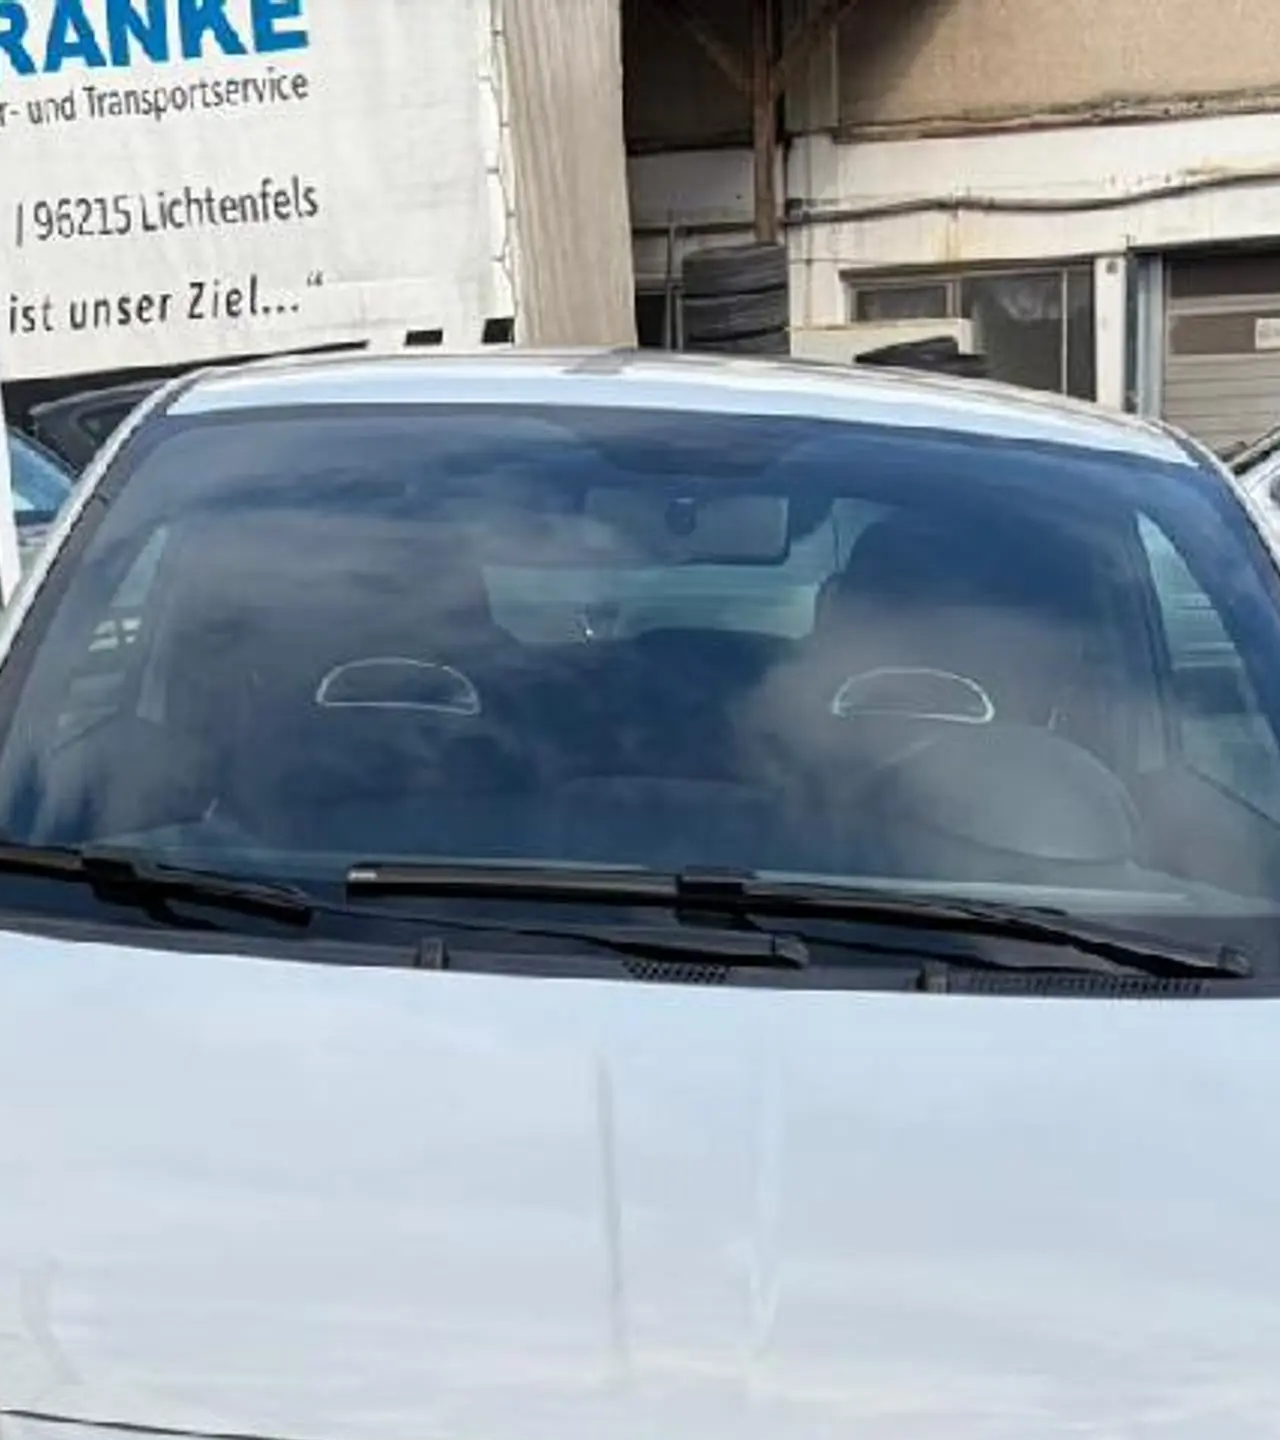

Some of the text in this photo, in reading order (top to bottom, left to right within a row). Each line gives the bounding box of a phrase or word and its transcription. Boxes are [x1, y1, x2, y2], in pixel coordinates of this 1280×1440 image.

[27, 89, 76, 124] und
[83, 66, 308, 120] Transportservice
[33, 194, 132, 241] 96215
[140, 174, 319, 232] Lichtenfels
[9, 293, 54, 333] ist
[70, 292, 173, 330] unser
